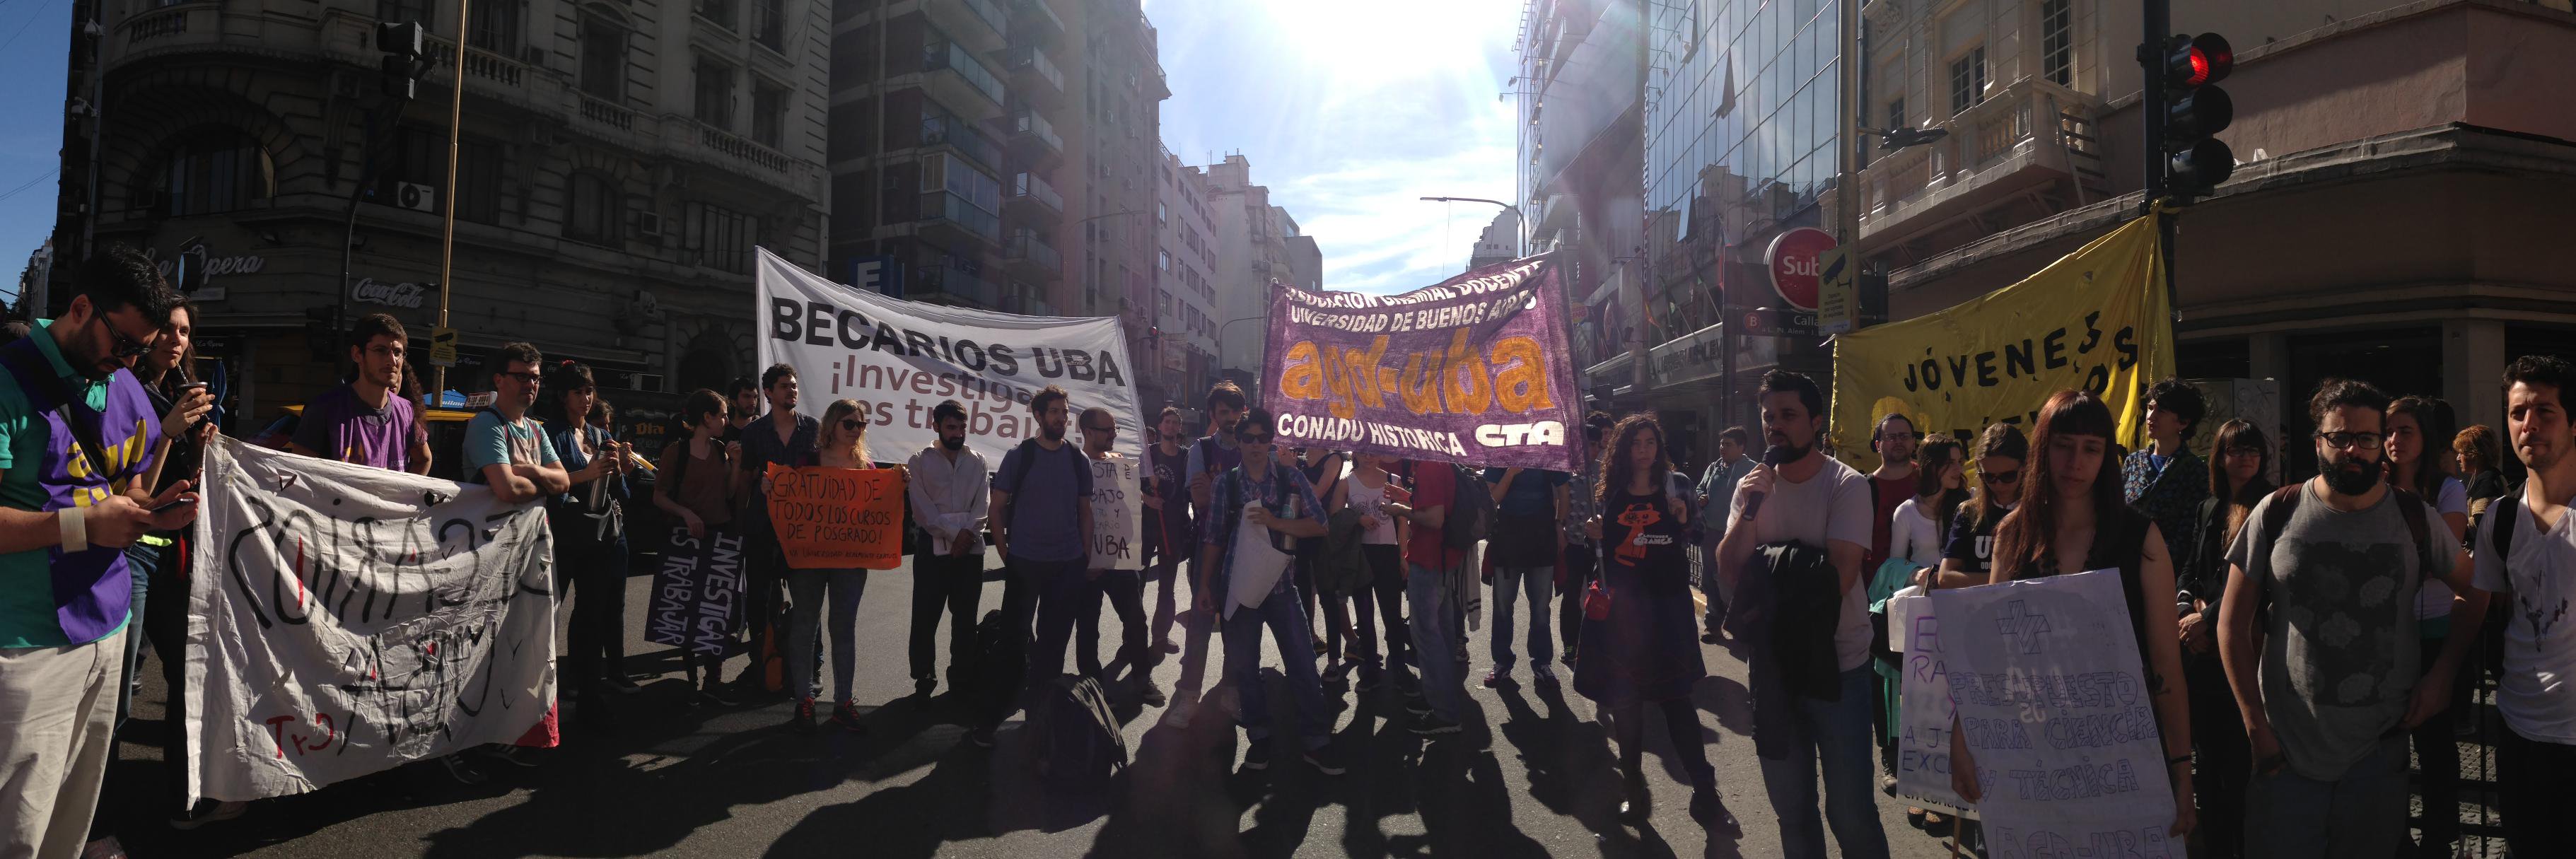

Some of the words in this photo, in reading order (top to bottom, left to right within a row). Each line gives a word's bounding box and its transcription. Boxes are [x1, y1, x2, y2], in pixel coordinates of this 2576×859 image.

[857, 260, 882, 293] E
[1783, 255, 1819, 276] Sub
[1390, 312, 1414, 332] DE
[1416, 302, 1488, 330] BUENOS
[1749, 316, 1758, 327] B
[1793, 315, 1819, 327] Calla
[771, 296, 1018, 376] BECARIOS
[1032, 347, 1126, 387] UBA
[832, 354, 1042, 413] ¡Investiga
[1277, 413, 1365, 442] CONADU
[1367, 421, 1468, 457] HISTORICA
[1475, 421, 1565, 448] CTA
[864, 479, 882, 503] DE
[774, 499, 824, 524] TODOS
[827, 504, 848, 525] LOS
[849, 508, 891, 526] CURSOS
[787, 523, 807, 539] DE
[814, 525, 883, 545] POSGRADO!
[1094, 533, 1131, 560] UBA
[653, 554, 699, 645] TRABAJAR
[691, 532, 743, 656] INVESTIGAR
[1949, 672, 2138, 708] PRESUPUESTO
[1964, 717, 2033, 750] PARA
